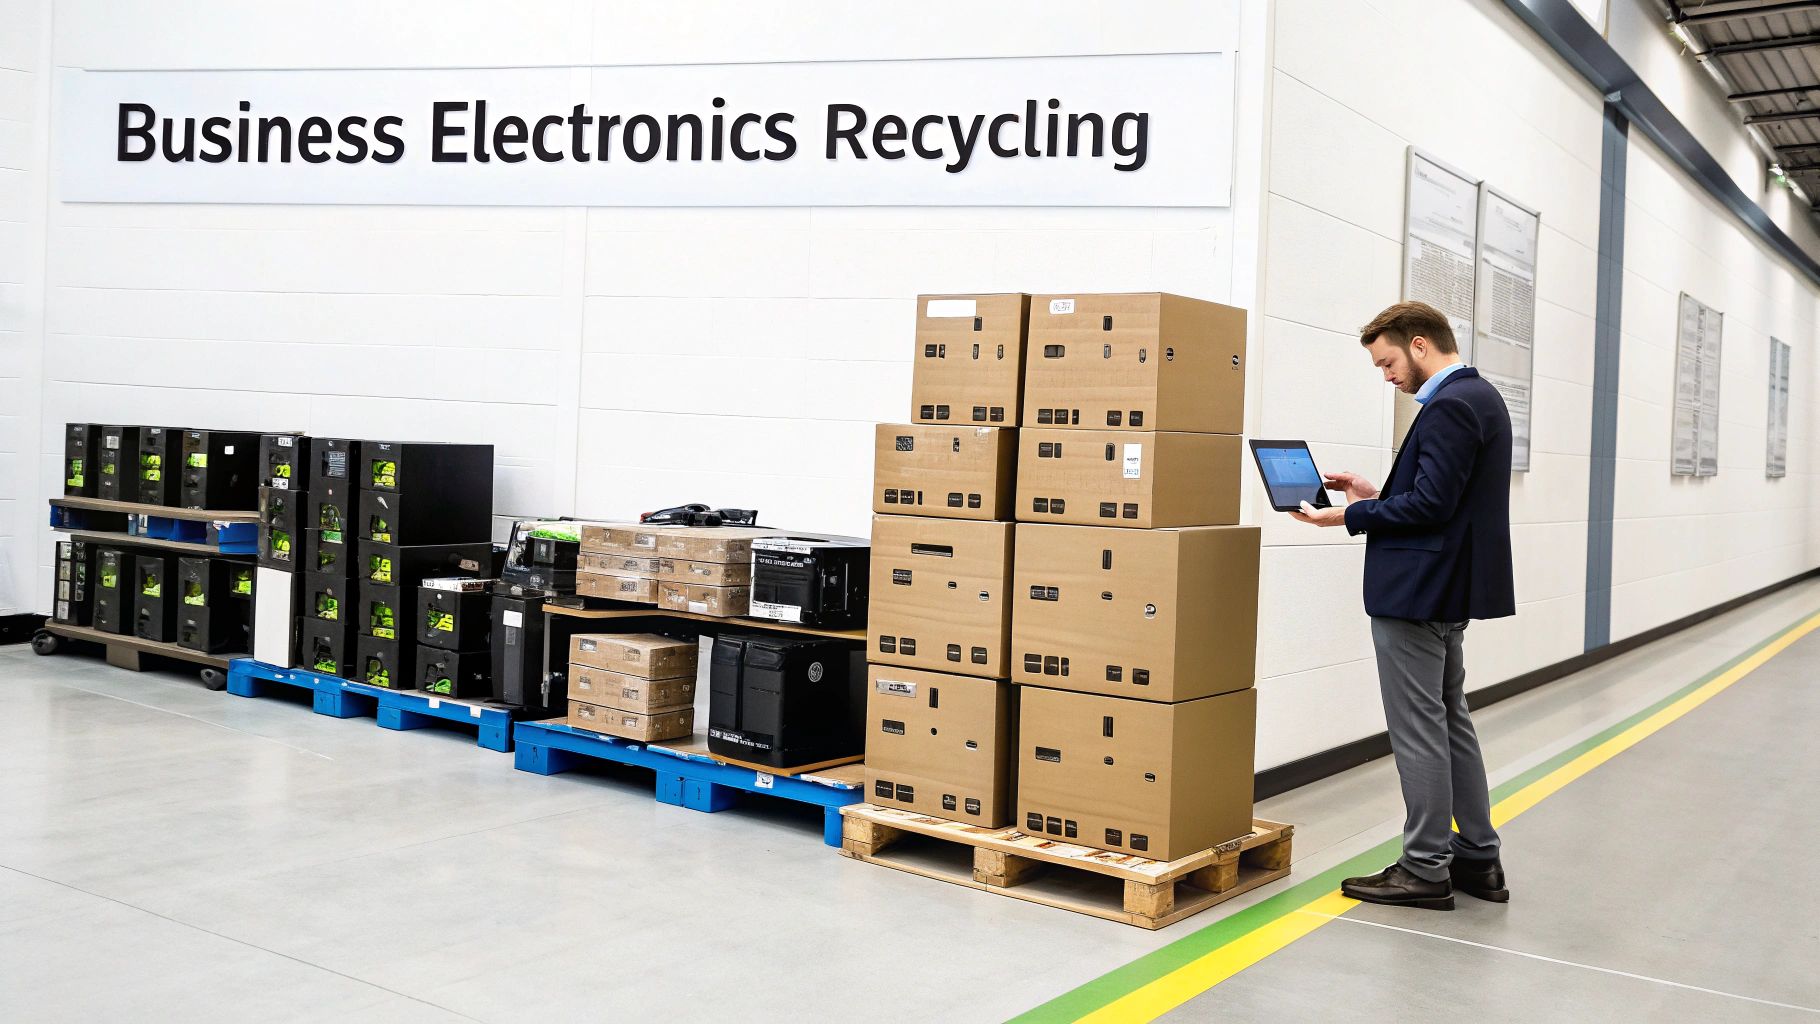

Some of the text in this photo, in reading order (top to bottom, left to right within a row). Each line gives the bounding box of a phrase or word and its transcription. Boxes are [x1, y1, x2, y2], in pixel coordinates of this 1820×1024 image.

[117, 96, 1149, 174] Business Electronics Recycling
